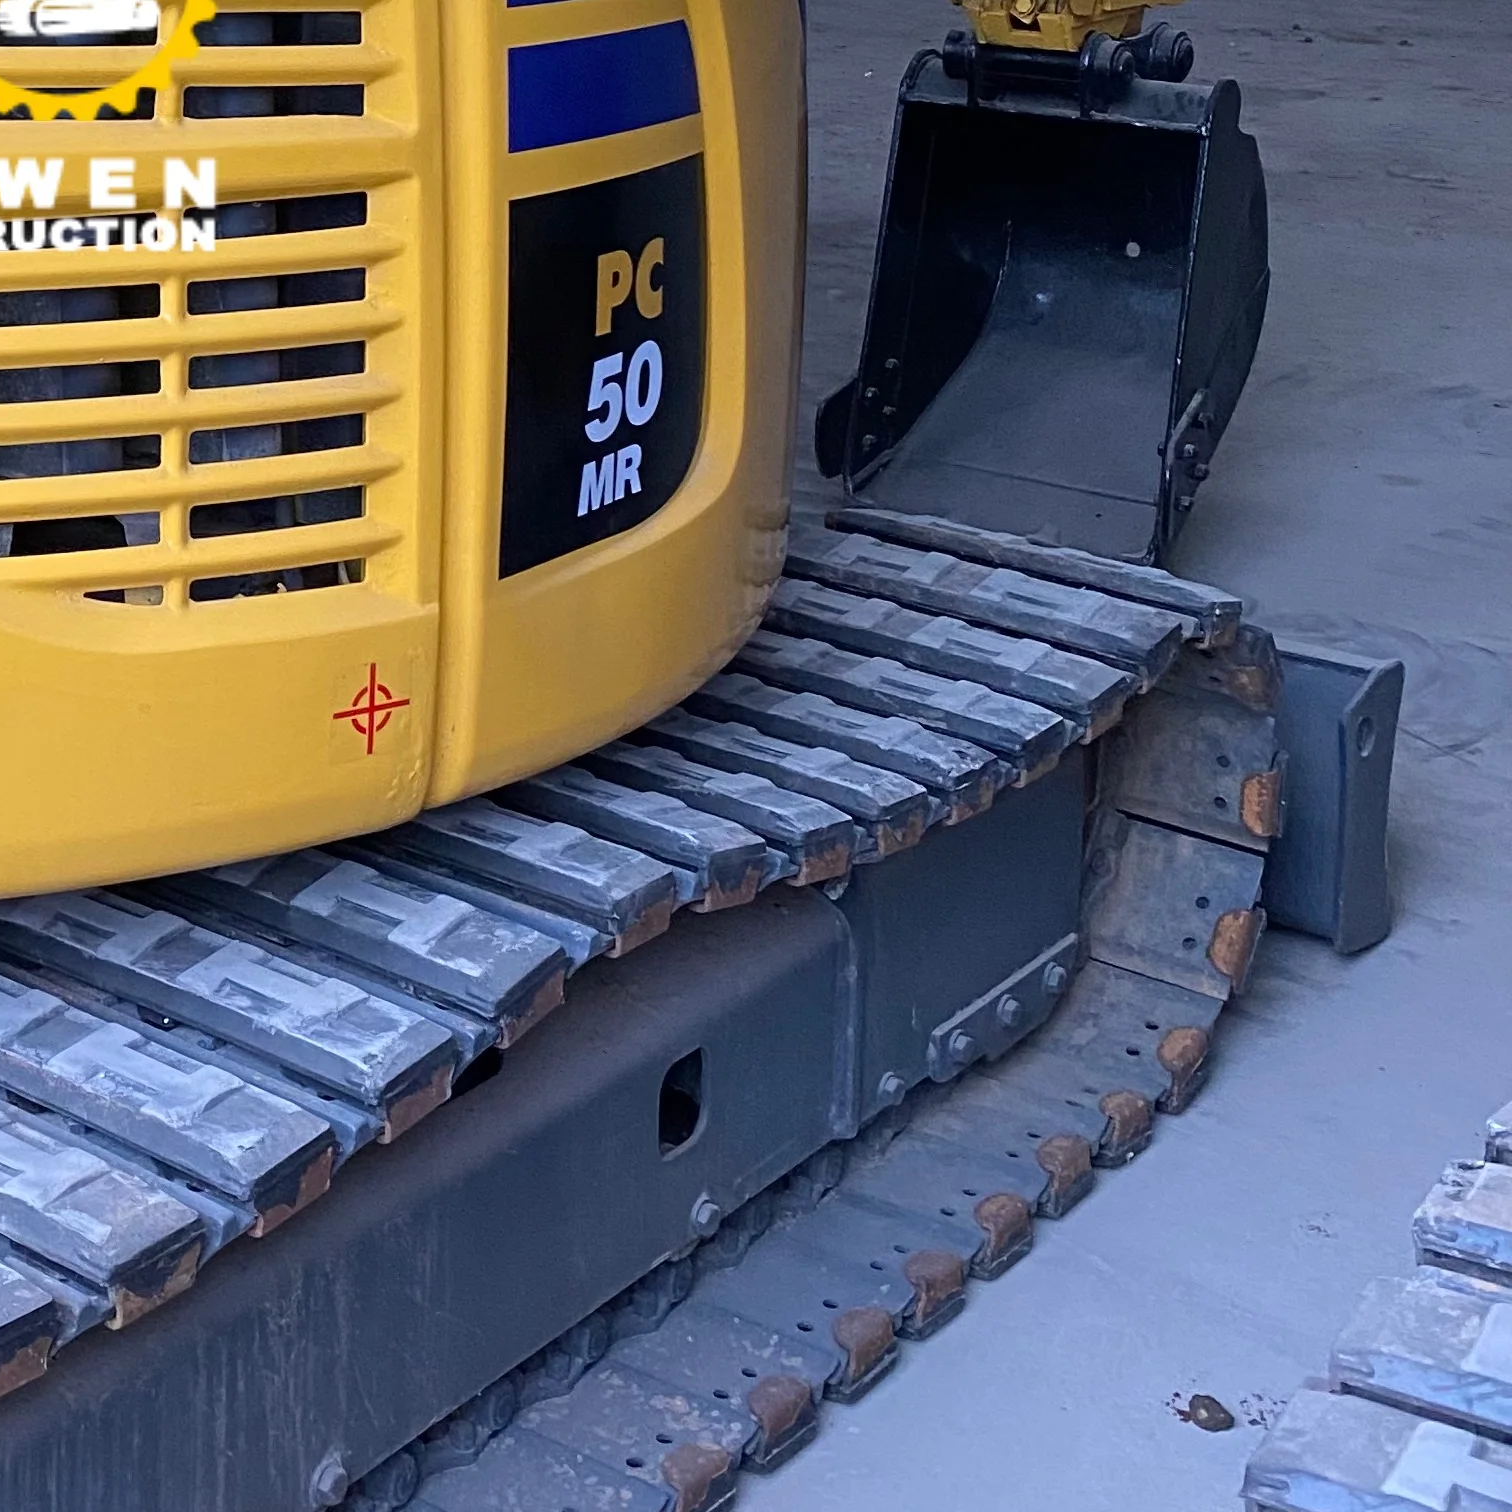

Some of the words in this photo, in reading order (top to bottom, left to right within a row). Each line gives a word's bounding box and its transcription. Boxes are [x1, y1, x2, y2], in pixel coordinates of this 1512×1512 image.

[595, 237, 664, 337] PC
[584, 340, 663, 443] 50
[577, 443, 642, 517] MR
